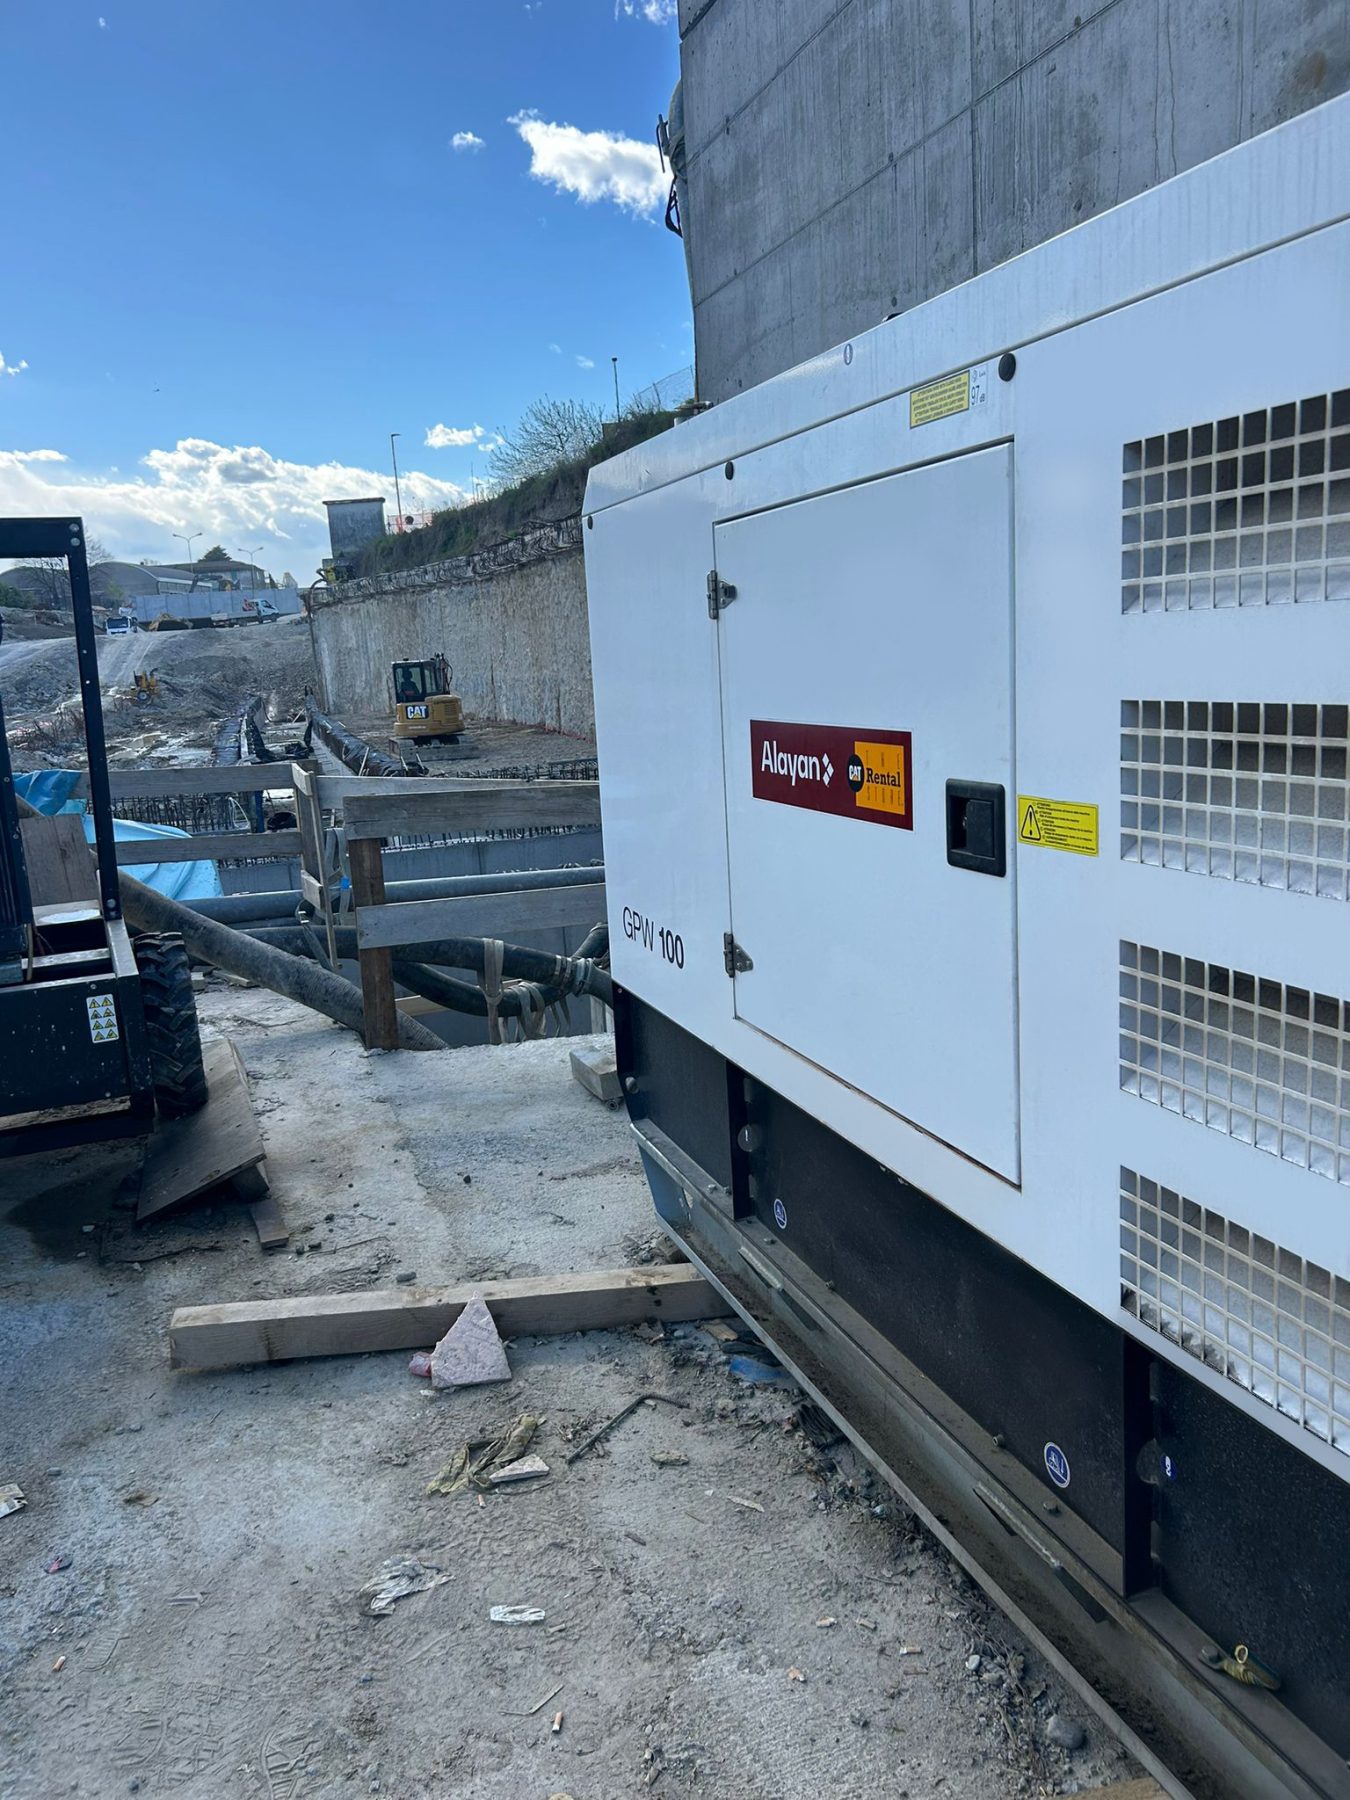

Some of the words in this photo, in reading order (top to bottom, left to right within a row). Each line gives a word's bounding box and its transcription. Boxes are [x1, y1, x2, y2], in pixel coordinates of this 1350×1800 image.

[971, 385, 980, 406] 97
[407, 706, 427, 719] CAT
[761, 740, 821, 786] Alayan
[848, 765, 862, 782] CAT
[866, 767, 901, 788] Rental
[622, 906, 654, 952] GPW
[658, 926, 685, 970] 100
